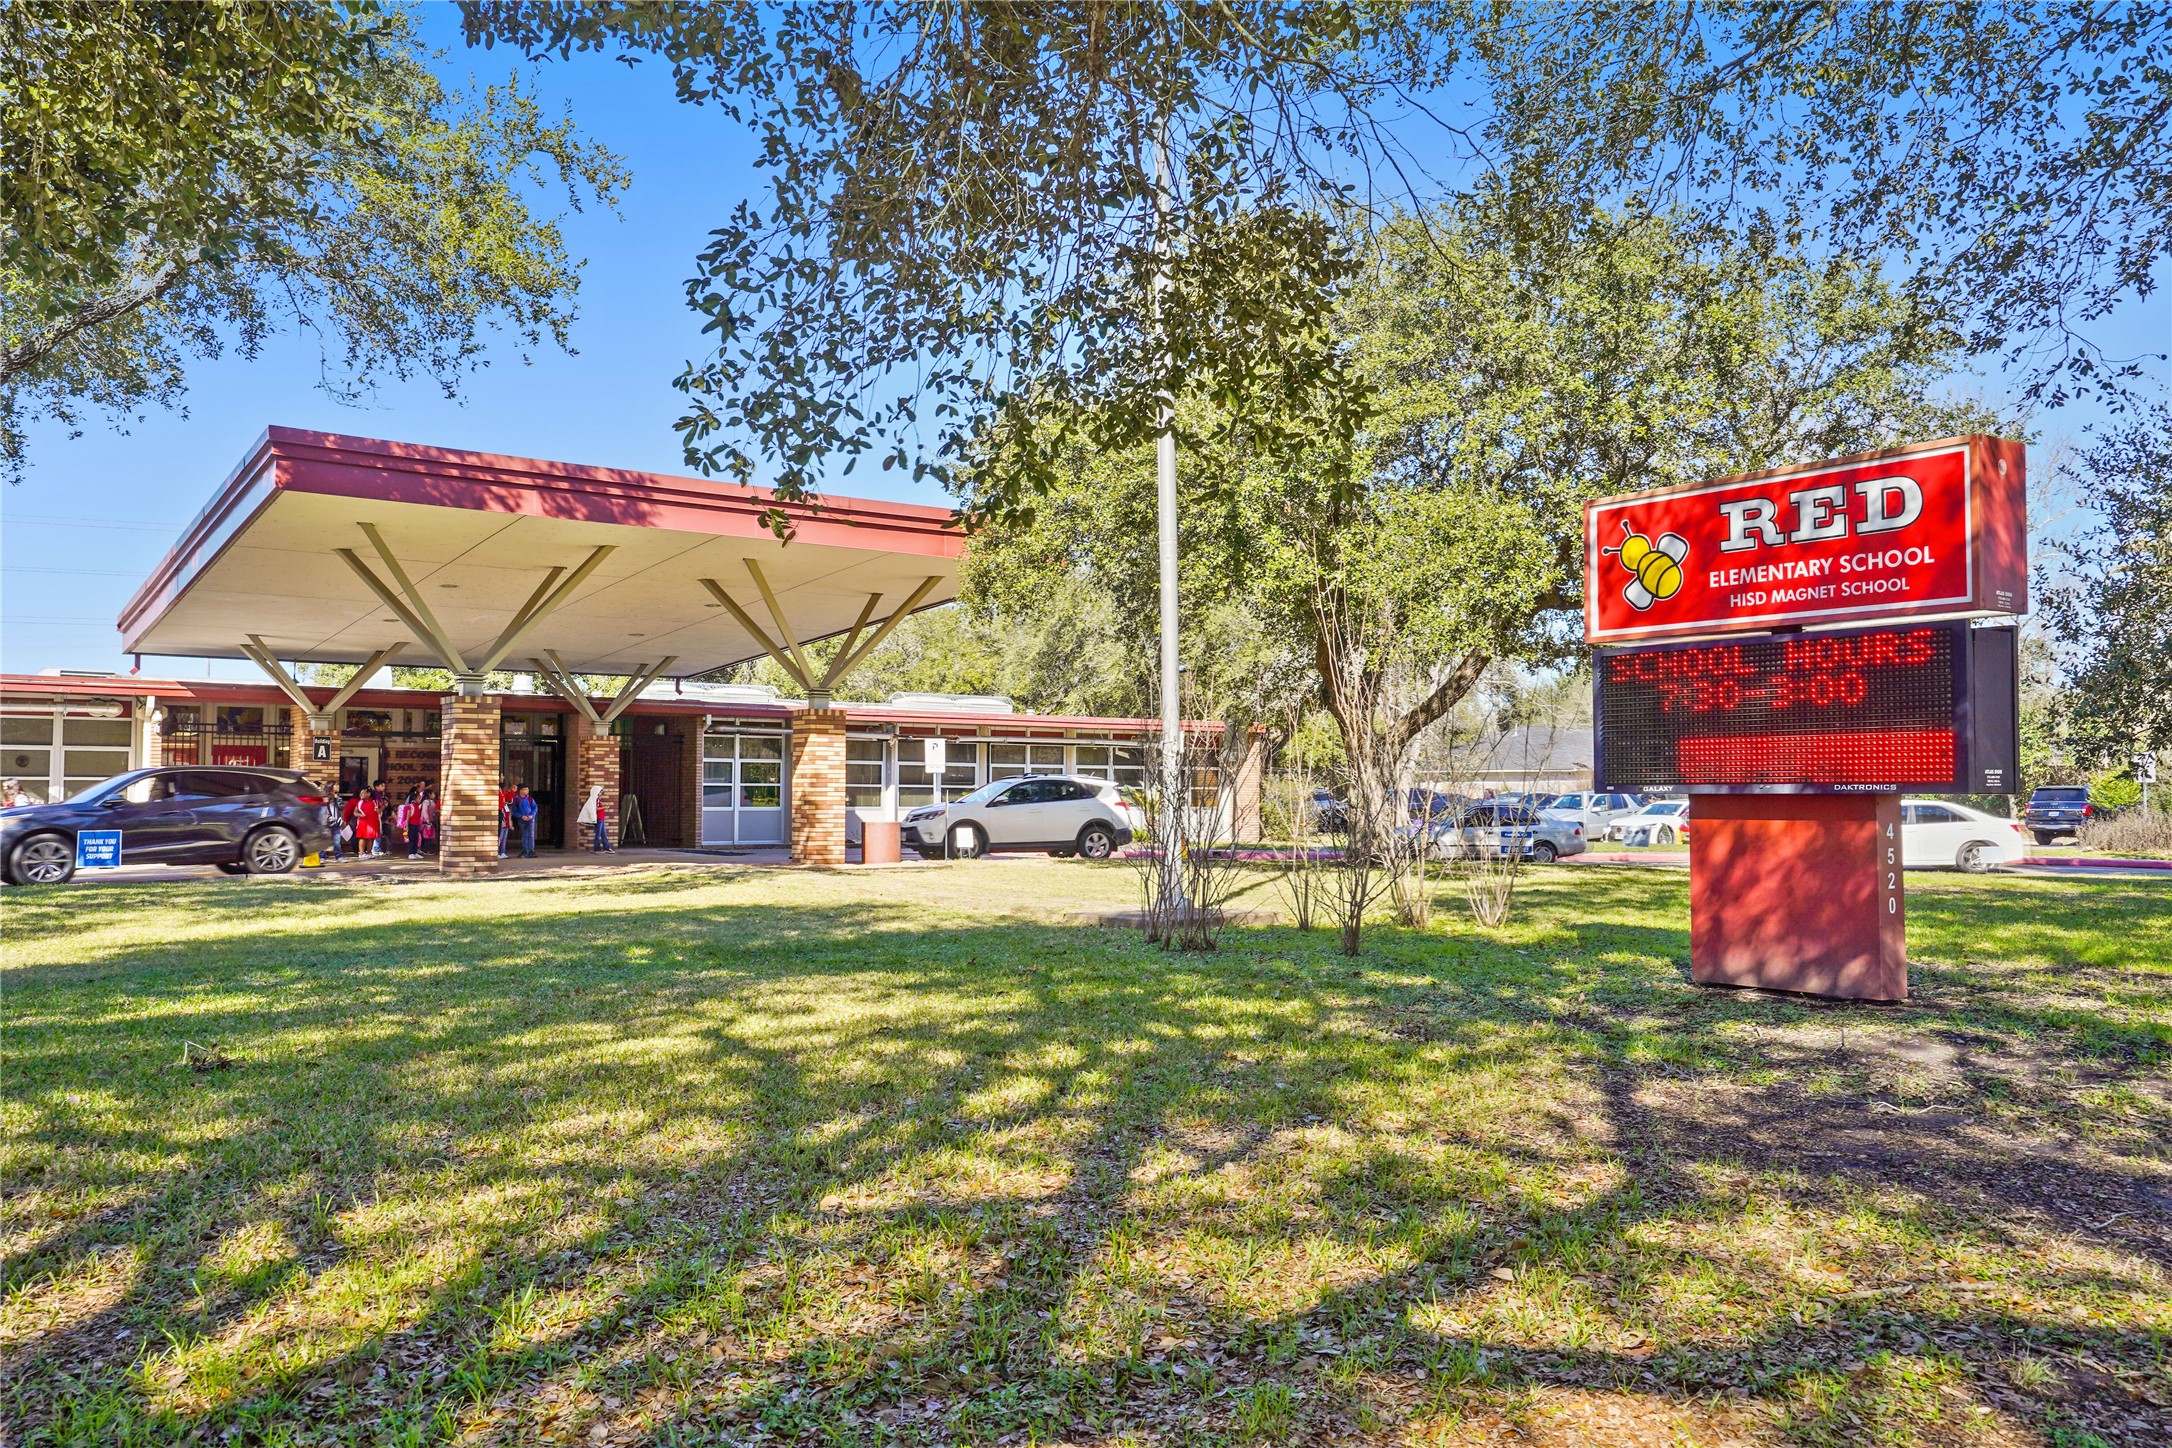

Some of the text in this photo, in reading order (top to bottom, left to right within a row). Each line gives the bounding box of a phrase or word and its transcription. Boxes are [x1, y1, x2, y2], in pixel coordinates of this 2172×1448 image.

[1719, 475, 1924, 553] RED
[1709, 546, 1935, 588] ELEMENTARY SCHOOL
[1730, 577, 1910, 607] HISD MAGNET SCHOOL
[1611, 630, 1935, 682] SCHOOL HOURS
[317, 745, 327, 758] A
